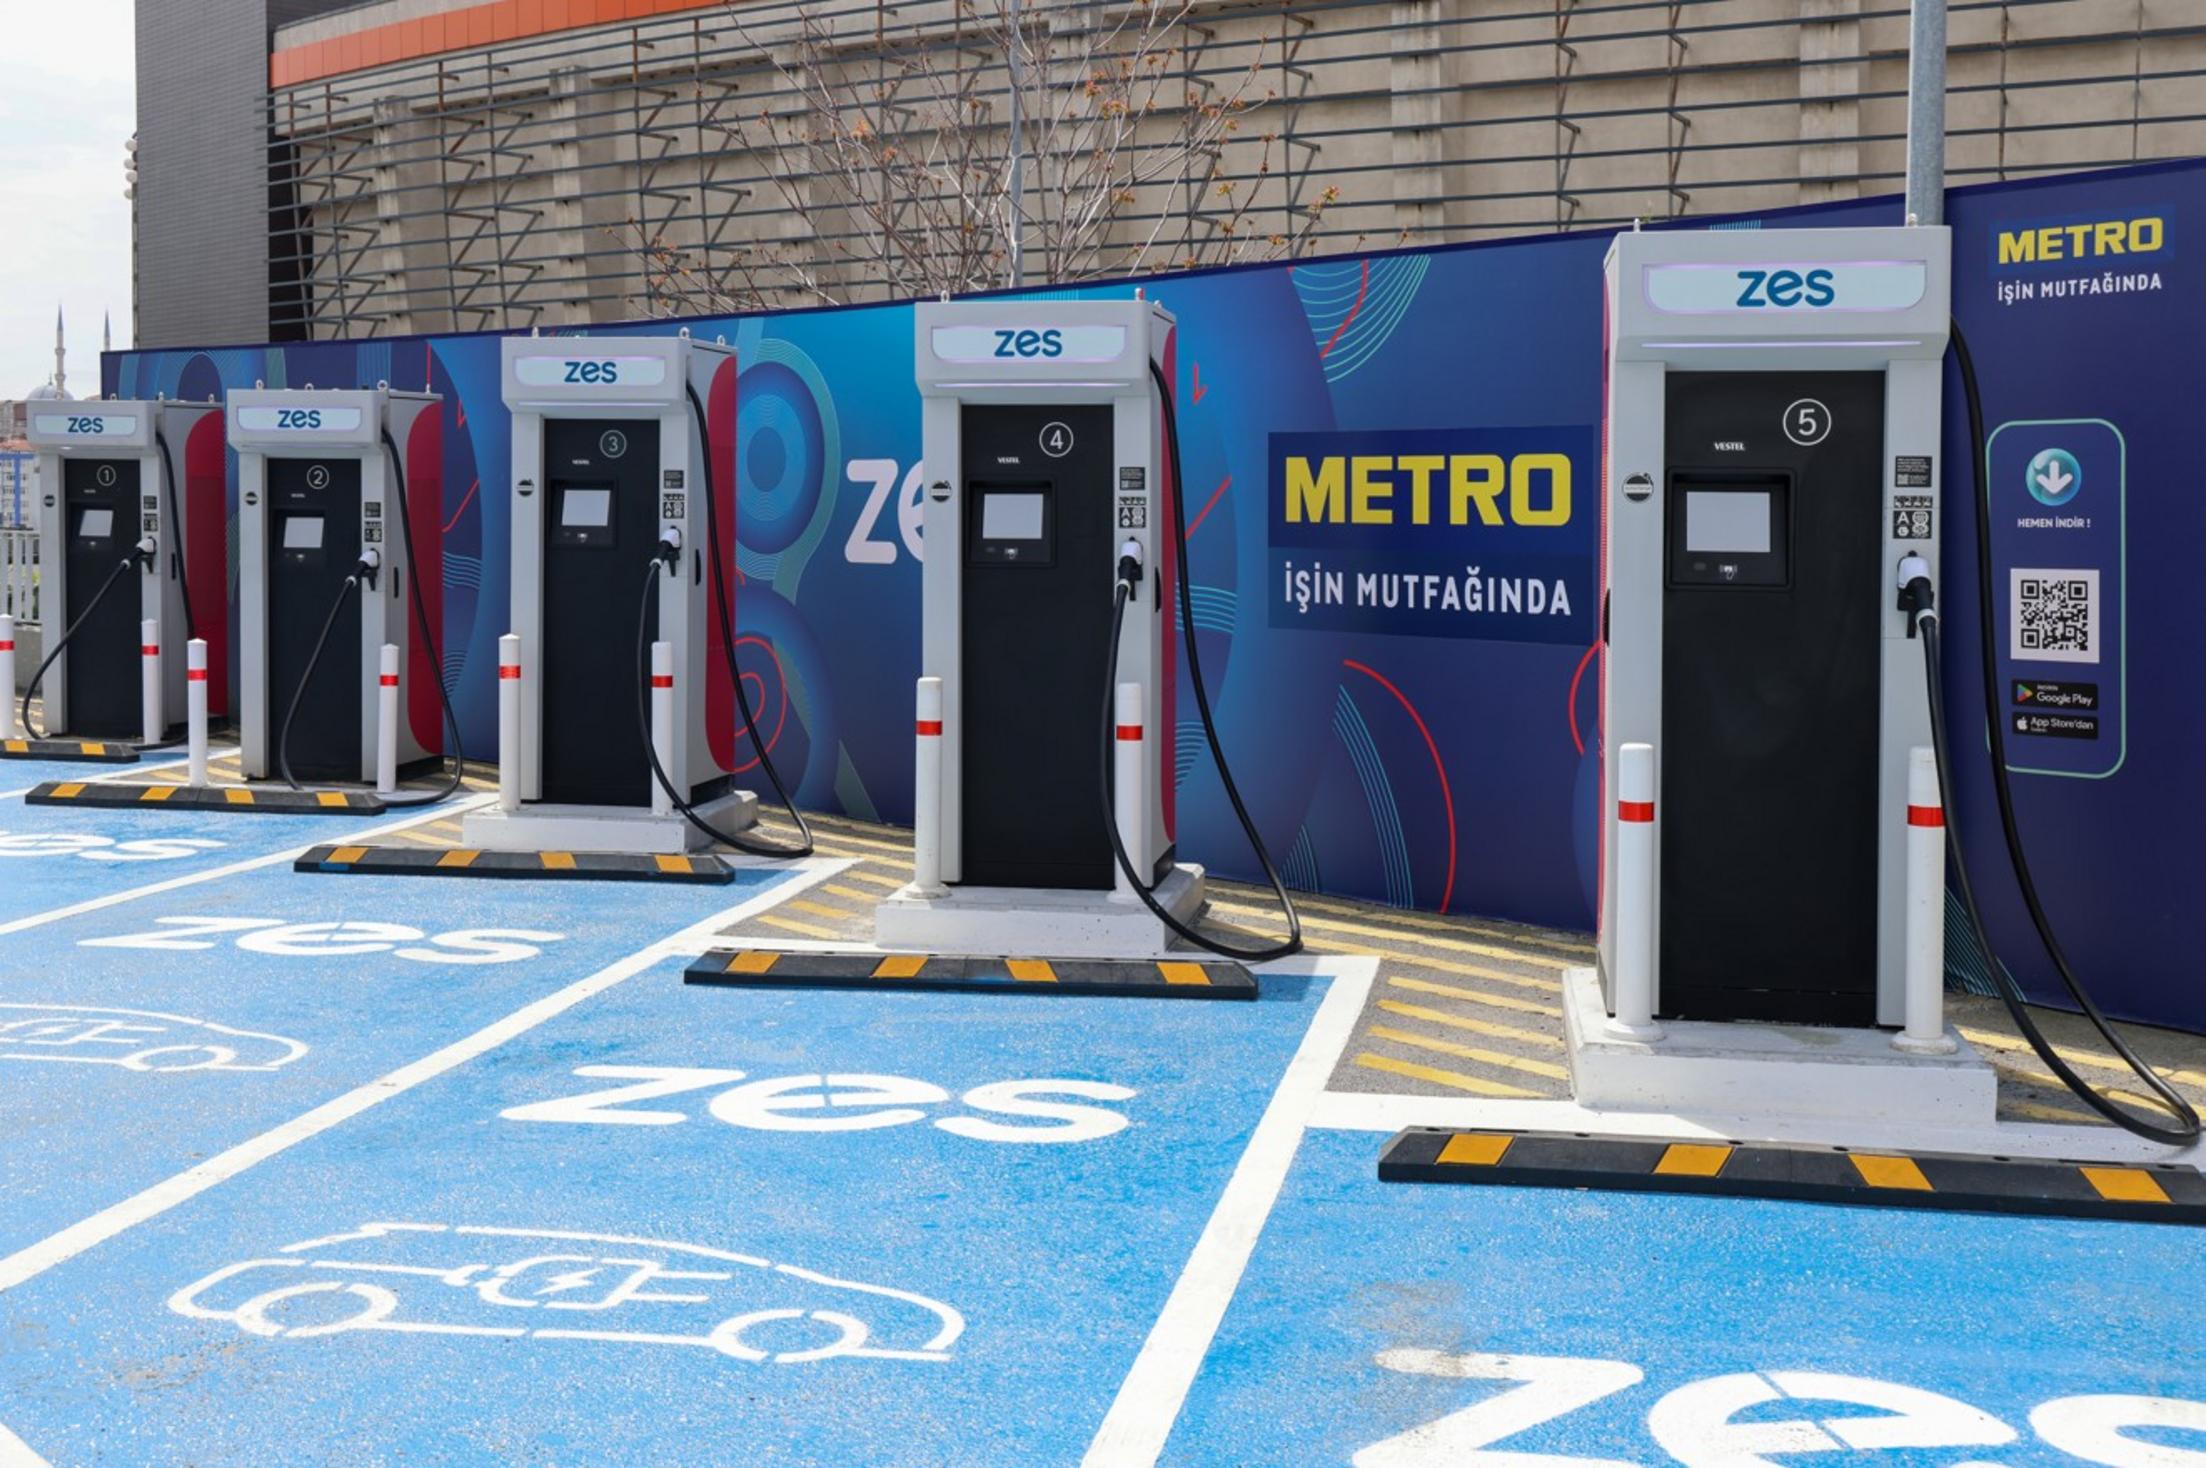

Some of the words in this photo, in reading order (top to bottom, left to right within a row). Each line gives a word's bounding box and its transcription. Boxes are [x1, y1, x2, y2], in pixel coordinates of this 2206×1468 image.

[1998, 217, 2164, 264] METRO
[1736, 269, 1836, 308] zes
[1998, 279, 2034, 306] İŞİN
[2040, 271, 2163, 298] MUTFAĞINDA
[994, 329, 1064, 358] zes
[564, 361, 618, 384] zes
[67, 416, 105, 434] zes
[277, 409, 322, 429] zes
[1797, 408, 1818, 436] 5
[608, 436, 619, 453] 3
[1049, 429, 1065, 450] 4
[312, 469, 325, 486] 2
[1285, 453, 1572, 527] METRO
[2017, 517, 2053, 528] HEMEN
[1285, 561, 1344, 614] İŞİN
[1357, 566, 1571, 616] MUTFAĞINDA
[2036, 691, 2071, 706] Google
[2072, 693, 2093, 707] Play
[2030, 716, 2050, 728] App
[77, 916, 567, 964] zes
[500, 1065, 1138, 1144] zes
